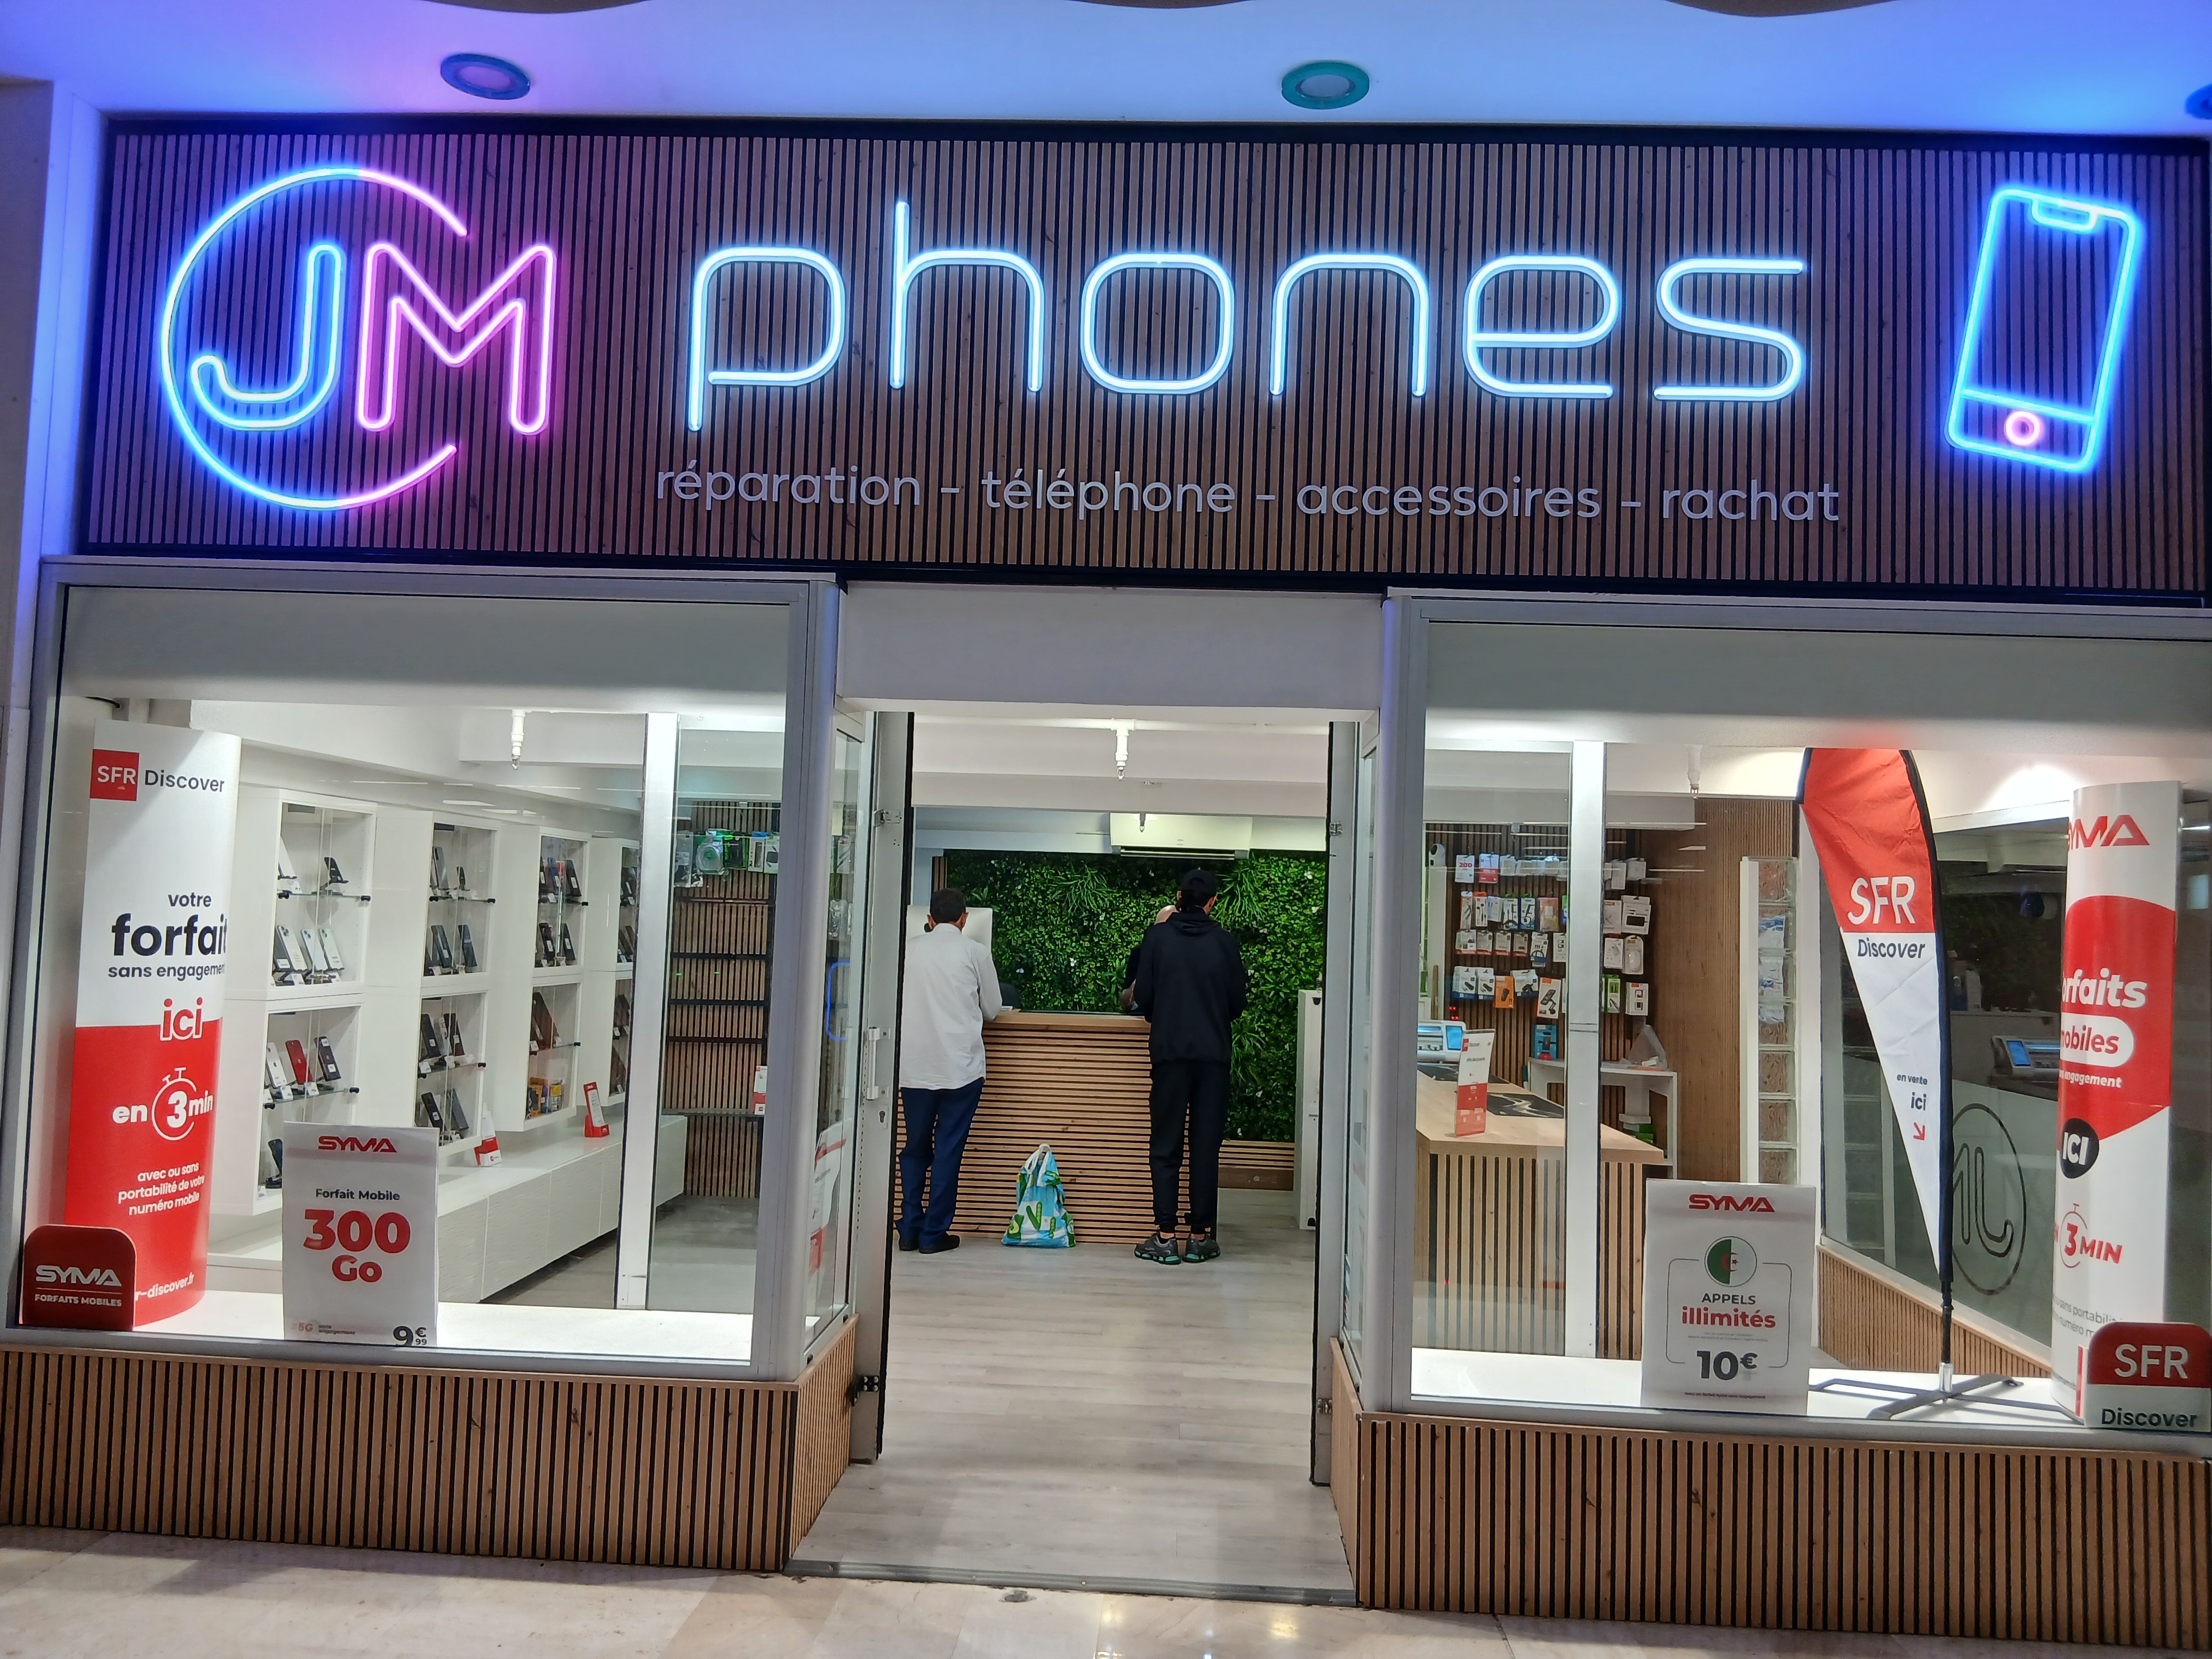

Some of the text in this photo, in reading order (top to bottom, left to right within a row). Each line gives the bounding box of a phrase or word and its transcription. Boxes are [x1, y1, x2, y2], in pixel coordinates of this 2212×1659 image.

[191, 200, 1804, 434] JM phones
[657, 459, 920, 511] réparation
[981, 468, 1235, 520] téléphone
[1296, 476, 1600, 518] accessoires
[1662, 479, 1840, 522] rachat
[97, 765, 225, 793] SFR Discover
[168, 892, 212, 908] votre
[1847, 876, 1916, 925] SFR
[111, 912, 228, 956] forfait
[1857, 937, 1926, 959] Discover
[108, 966, 152, 978] sans
[2062, 968, 2147, 1009] orfaits
[160, 996, 203, 1041] ici
[1896, 1074, 1928, 1085] en vente
[2064, 1071, 2123, 1088] engagement
[112, 1090, 214, 1128] en 3 min
[1911, 1091, 1927, 1111] ici
[318, 1135, 397, 1153] SYMA
[2062, 1131, 2089, 1166] ICI
[137, 1162, 200, 1182] avec ou sans
[118, 1180, 177, 1205] portabilité
[178, 1179, 189, 1192] de
[128, 1190, 200, 1216] numéro mobile
[316, 1188, 401, 1201] Forfait Mobile
[1688, 1194, 1775, 1213] SYMA
[303, 1208, 411, 1254] 300
[2064, 1222, 2079, 1257] 3
[2079, 1236, 2123, 1264] MIN
[35, 1264, 122, 1287] SYMA
[331, 1254, 383, 1283] Go
[135, 1272, 195, 1302] r-discover.fr
[1701, 1293, 1757, 1306] APPELS
[35, 1294, 122, 1307] FORFAITS MOBILES
[1682, 1306, 1776, 1329] illimités
[2114, 1343, 2189, 1379] SFR
[2101, 1407, 2197, 1427] Discover
